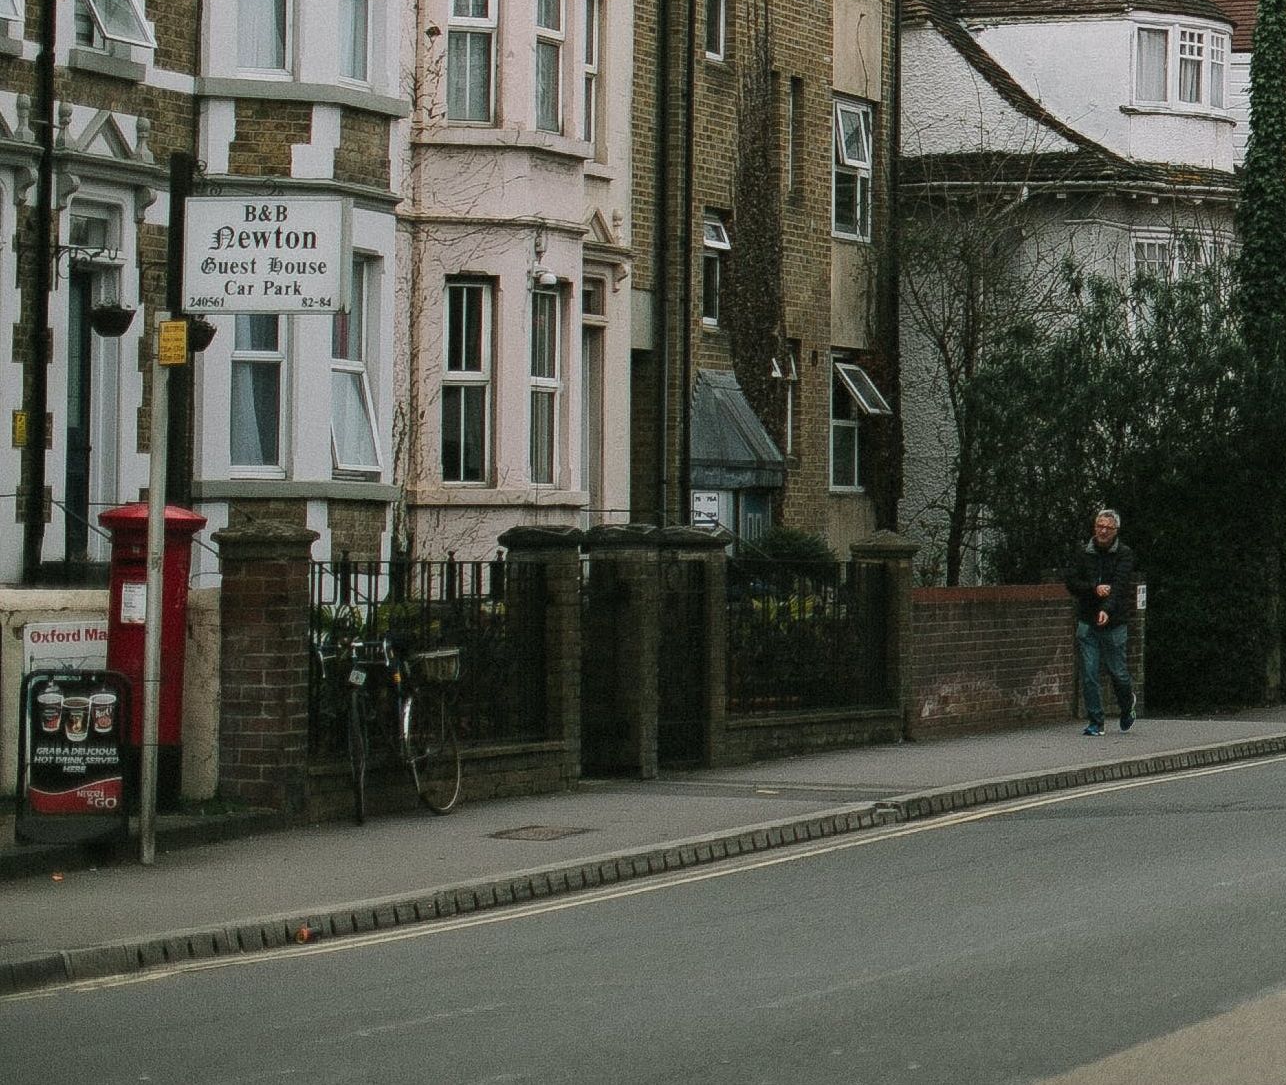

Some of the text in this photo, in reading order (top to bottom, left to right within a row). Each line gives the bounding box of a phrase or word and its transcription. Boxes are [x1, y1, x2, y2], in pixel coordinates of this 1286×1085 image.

[243, 204, 288, 223] B&B
[208, 225, 318, 251] Newton
[200, 256, 327, 275] Guest House
[224, 280, 303, 296] Car Park
[189, 296, 332, 308] 240561 82-84
[30, 628, 109, 644] Oxford Ma
[70, 747, 117, 756] DELICIOUS
[33, 756, 55, 764] HOT
[94, 797, 117, 809] GO
